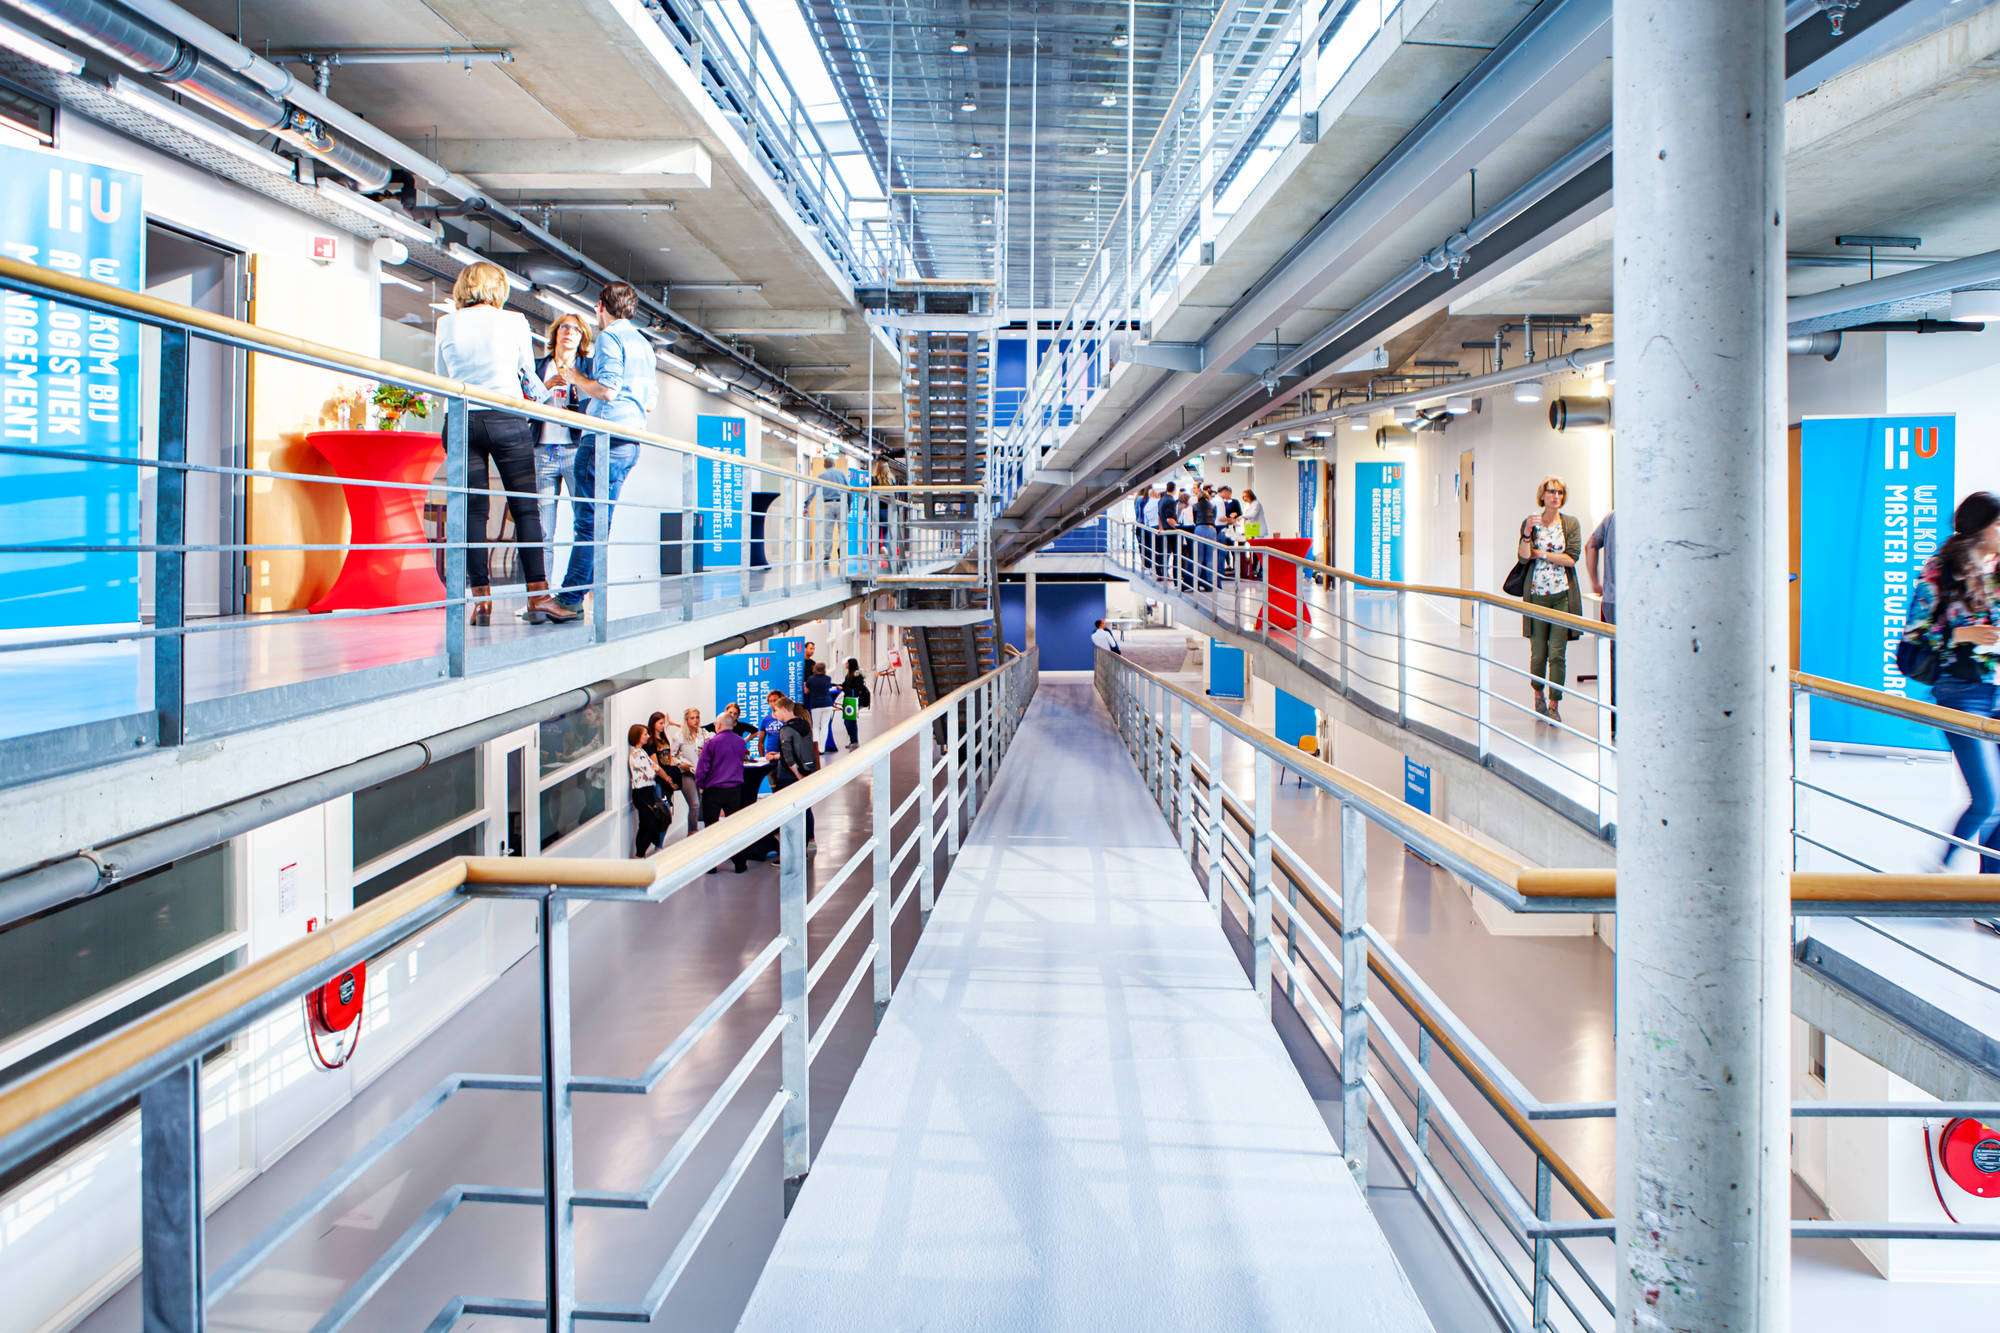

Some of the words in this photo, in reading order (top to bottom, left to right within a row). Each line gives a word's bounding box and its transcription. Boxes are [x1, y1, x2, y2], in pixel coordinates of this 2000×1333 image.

[48, 168, 122, 233] HU
[88, 257, 120, 375] WKOM
[4, 241, 39, 444] MNAGEMENT
[88, 384, 119, 423] BIJ
[722, 421, 741, 442] HU
[1884, 427, 1939, 470] HU
[1382, 465, 1401, 484] HU
[1393, 488, 1401, 523] WELKOM
[1884, 485, 1908, 564] MASTER
[748, 657, 770, 676] HU
[788, 661, 796, 702] COMMUNIC
[760, 681, 770, 718] WELKOM
